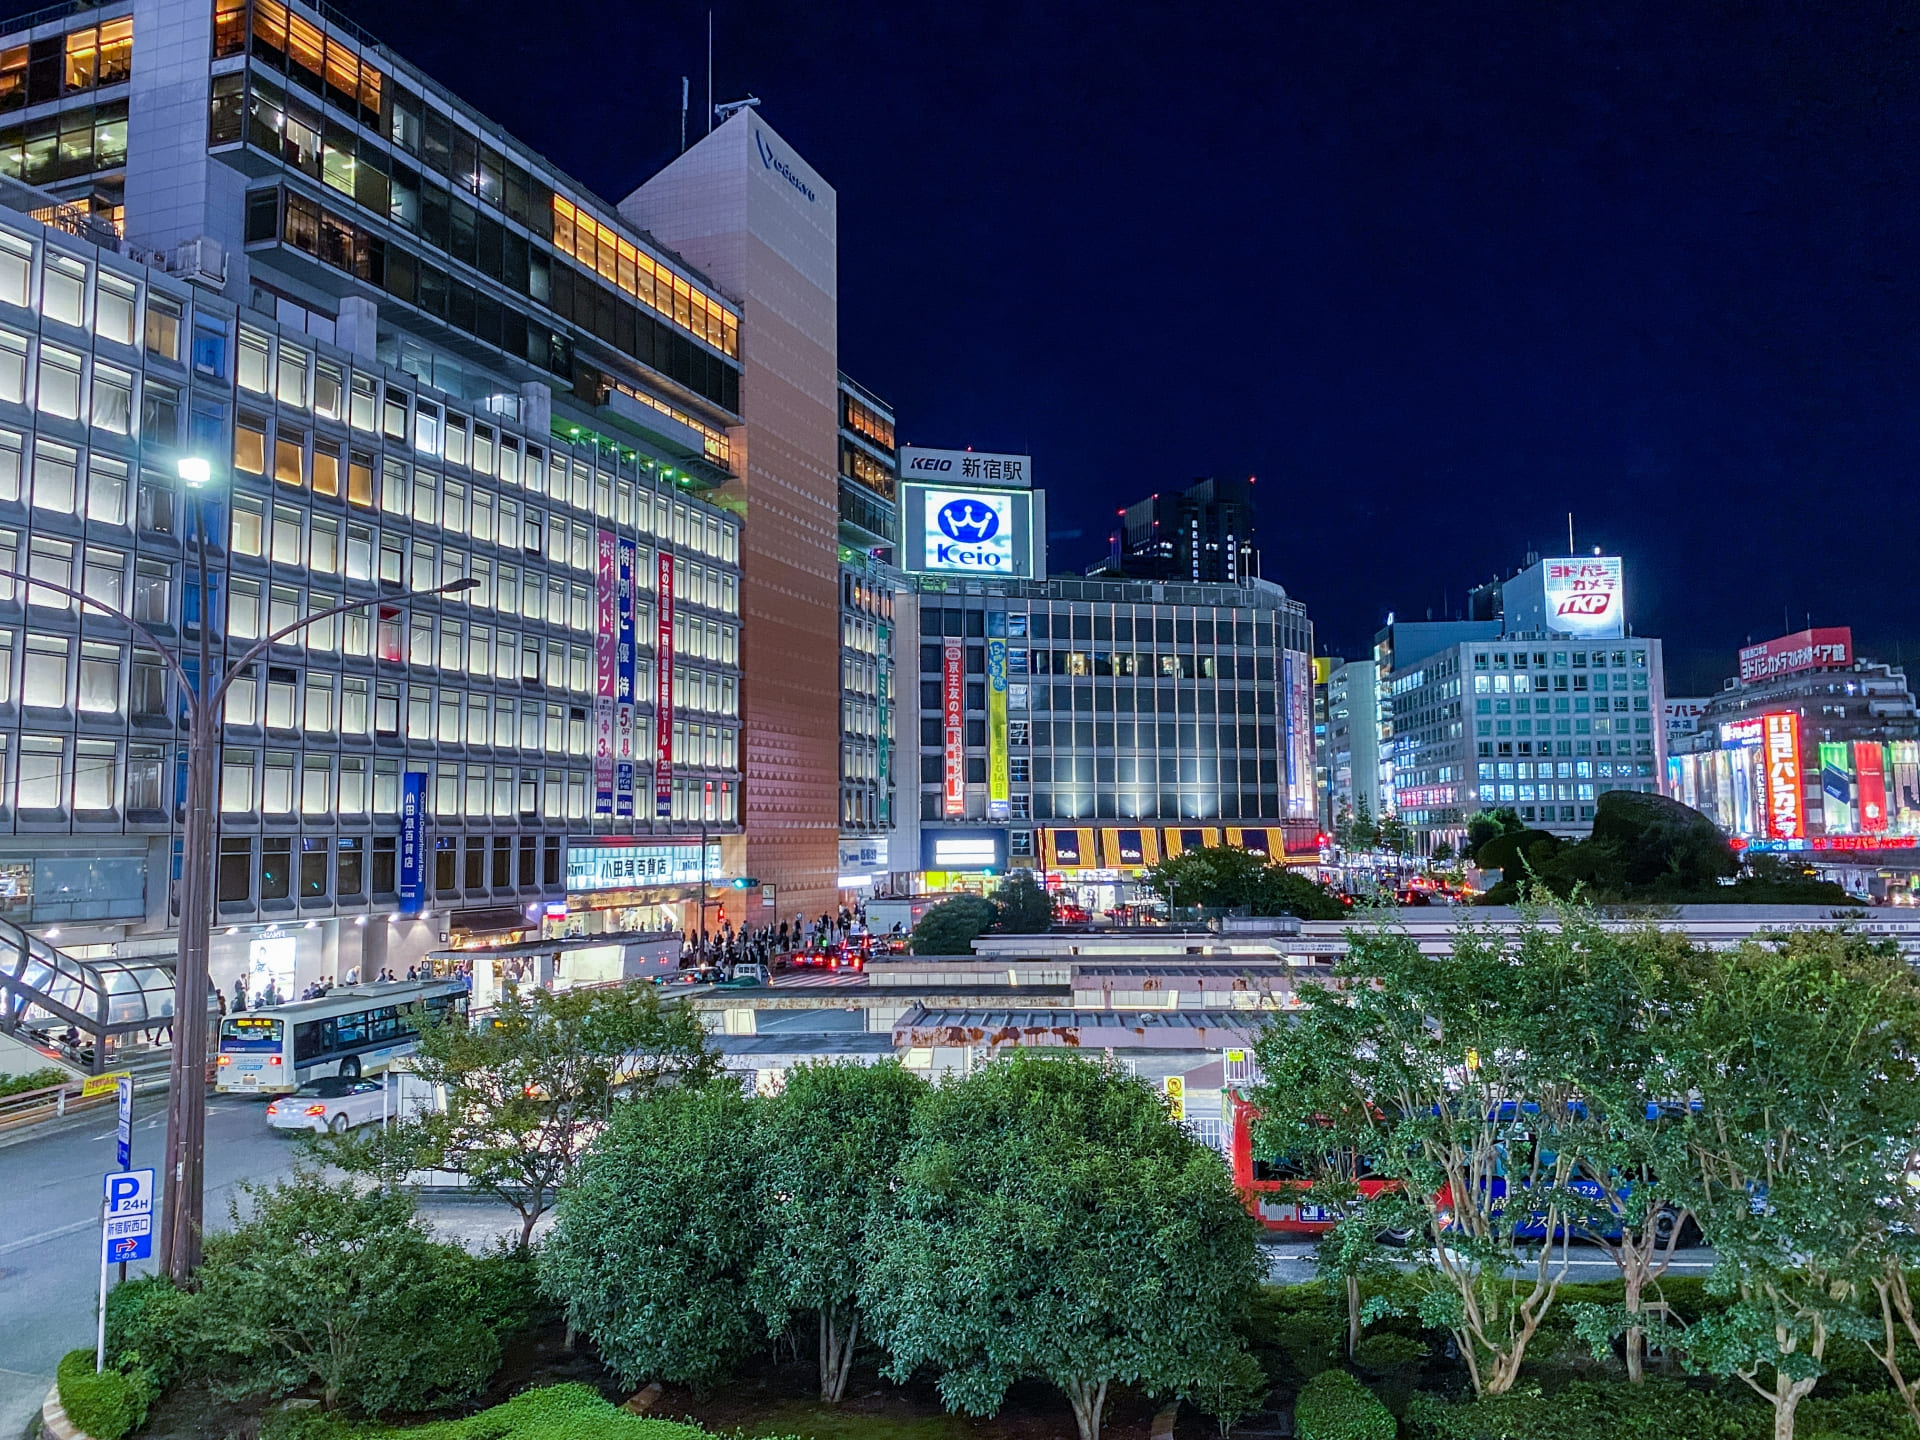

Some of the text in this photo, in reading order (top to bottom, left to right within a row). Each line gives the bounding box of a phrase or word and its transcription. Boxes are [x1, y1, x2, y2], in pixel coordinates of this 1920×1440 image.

[910, 457, 1023, 481] KEIO 新宿駅
[937, 543, 1001, 567] Keio
[1550, 565, 1609, 579] ヨドバシ
[1572, 579, 1618, 591] カメラ
[1559, 594, 1608, 614] TKP
[599, 539, 612, 693] ポイントアップ
[619, 546, 631, 698] 特別ご優待
[948, 660, 960, 727] 京王友の会
[1769, 733, 1797, 837] ヨドバシカメラ
[404, 791, 415, 869] 小田急百貨店
[1121, 849, 1141, 858] Keio
[601, 857, 667, 880] 小田急百貨店
[110, 1177, 140, 1213] P
[122, 1199, 148, 1211] 24H
[108, 1218, 149, 1236] 新宿駅西口
[114, 1251, 138, 1261] この先
